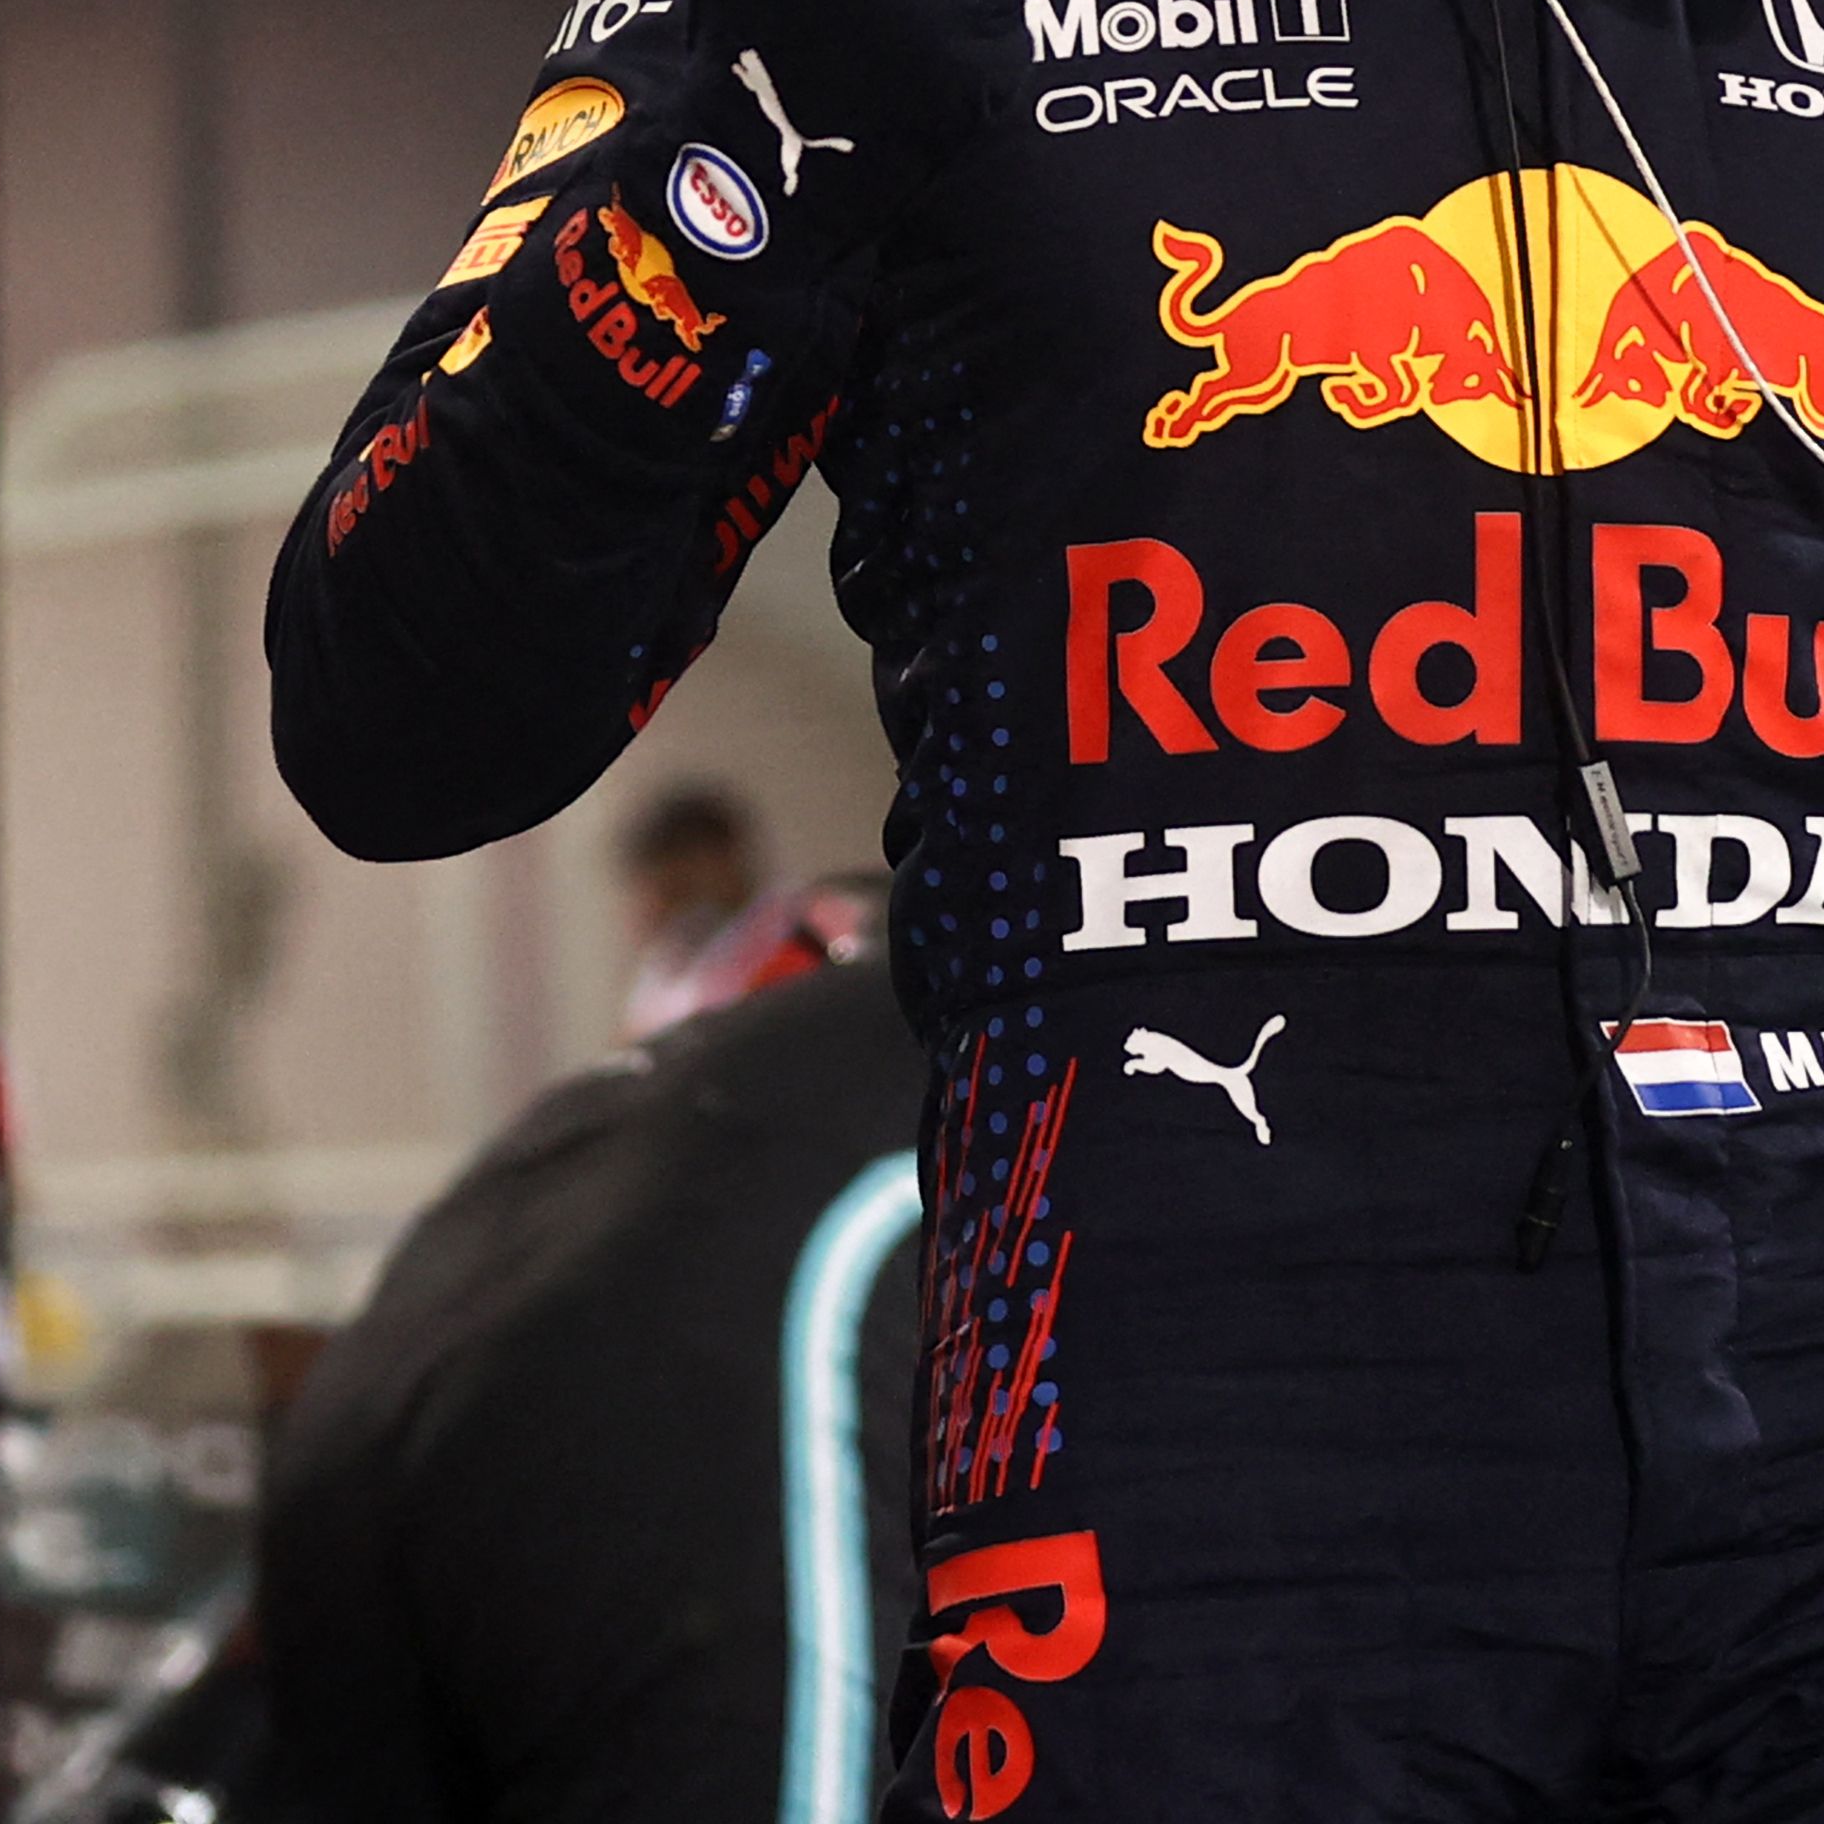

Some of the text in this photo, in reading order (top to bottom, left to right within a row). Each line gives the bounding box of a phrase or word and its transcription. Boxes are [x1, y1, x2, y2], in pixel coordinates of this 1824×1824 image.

[1035, 67, 1360, 134] ORACLE
[554, 206, 702, 408] Red Bull
[1066, 512, 1524, 765] Red
